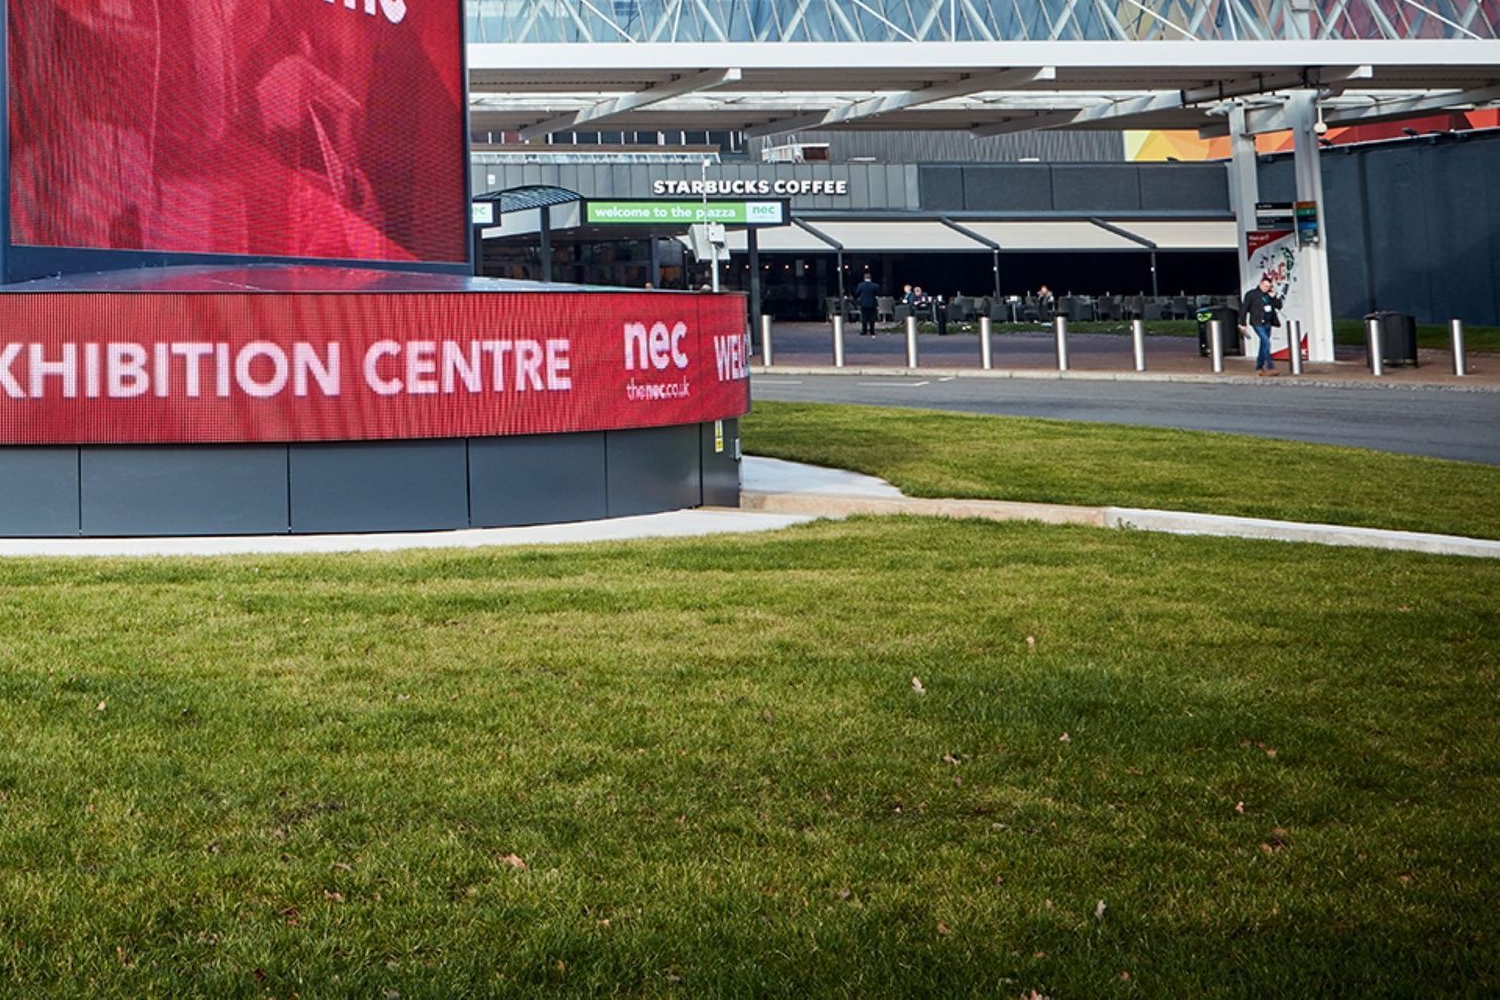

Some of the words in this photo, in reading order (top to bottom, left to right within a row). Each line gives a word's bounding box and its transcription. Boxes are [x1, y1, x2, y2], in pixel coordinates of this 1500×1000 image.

[653, 180, 769, 195] STARBUCKS
[774, 180, 847, 195] COFFEE
[595, 206, 650, 218] welcome
[653, 207, 668, 218] to
[671, 206, 692, 218] the
[695, 207, 736, 221] pazza
[752, 206, 775, 216] nec
[623, 321, 689, 370] nec
[713, 333, 750, 382] WEL
[364, 339, 573, 395] CENTRE
